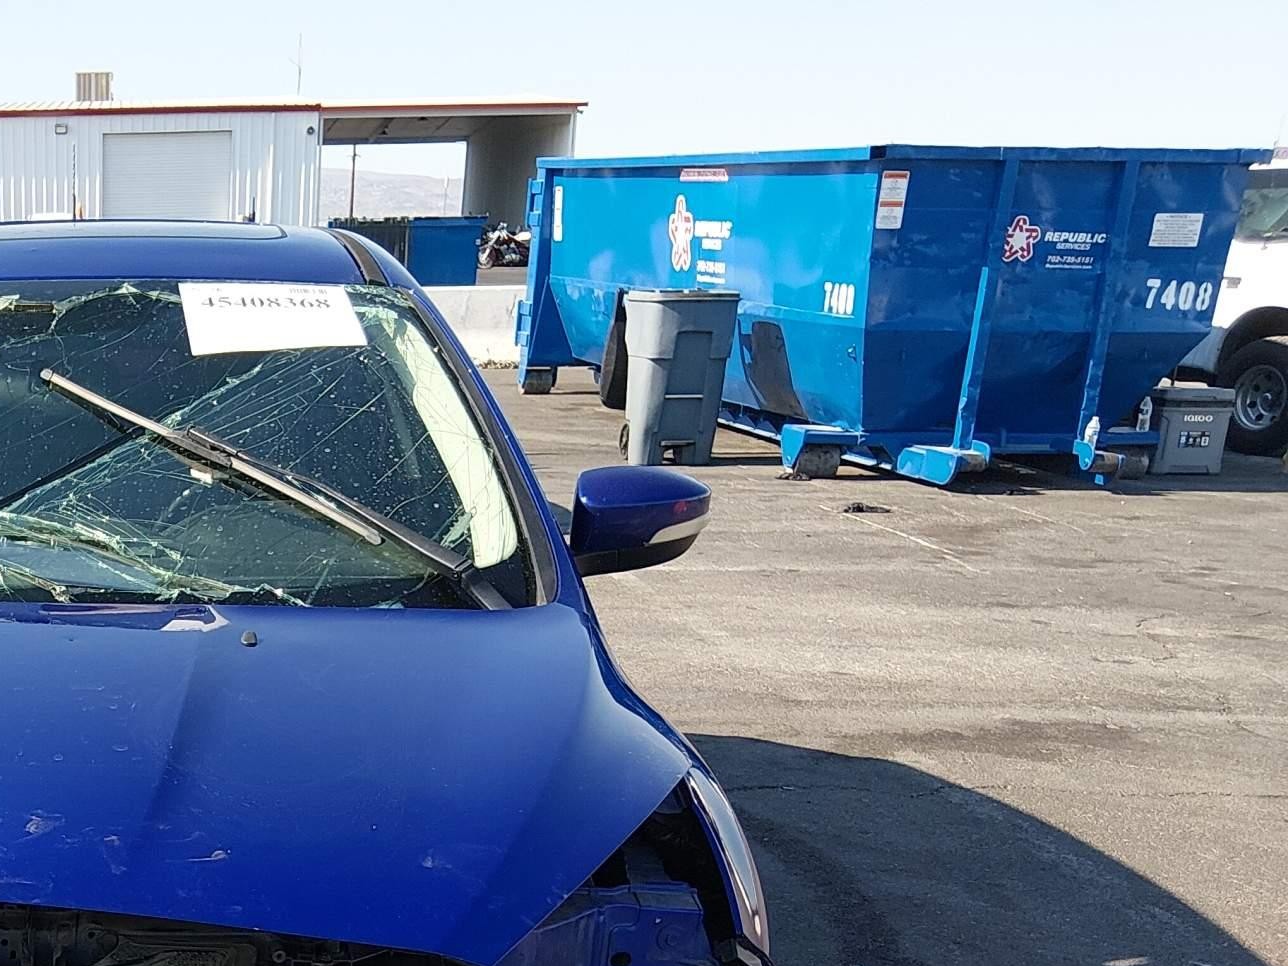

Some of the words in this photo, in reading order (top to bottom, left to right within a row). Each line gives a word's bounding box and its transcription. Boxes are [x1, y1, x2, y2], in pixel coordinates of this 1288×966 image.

[1043, 231, 1107, 243] REPUBLIC
[1145, 278, 1213, 311] 7408
[201, 296, 331, 309] 45408368
